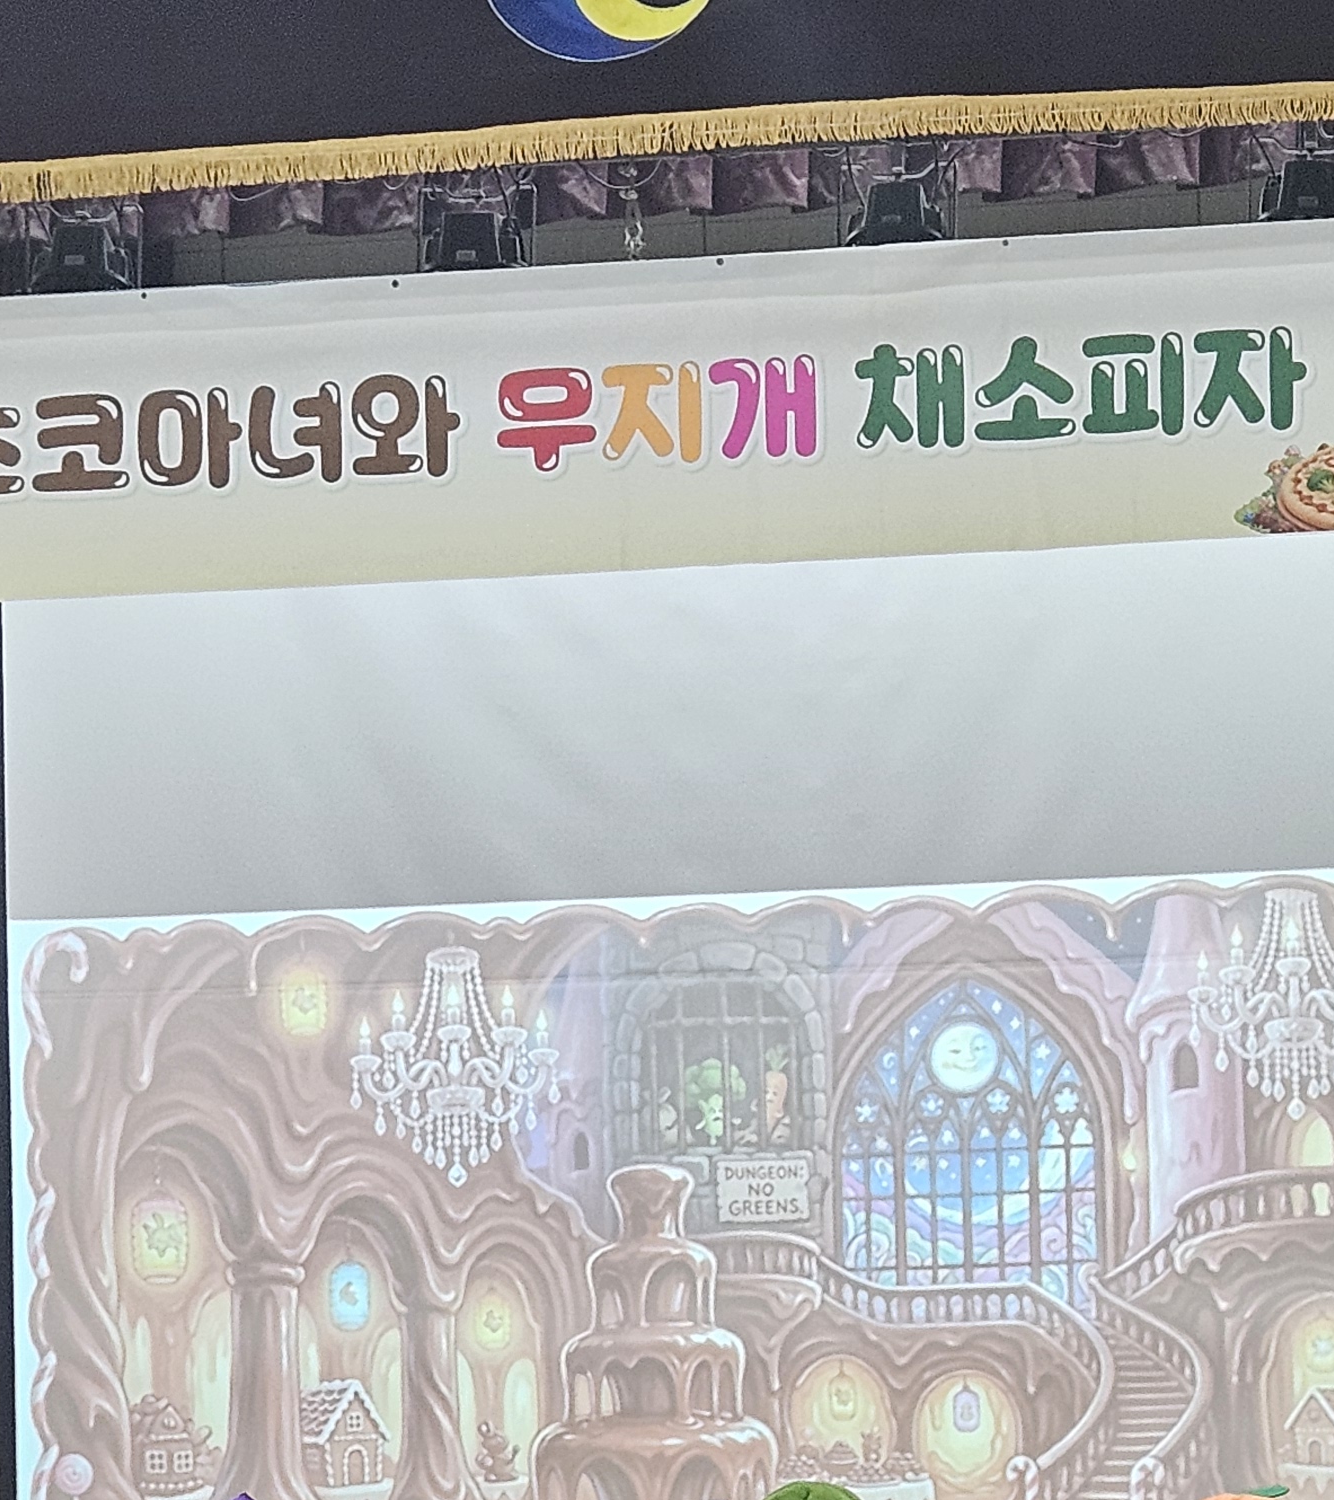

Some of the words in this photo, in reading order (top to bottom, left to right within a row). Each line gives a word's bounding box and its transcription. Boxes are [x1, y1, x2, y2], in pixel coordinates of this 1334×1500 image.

[497, 353, 818, 472] 무지개
[856, 326, 1307, 450] 채소피자
[724, 1165, 804, 1180] DUNGEON:
[748, 1183, 774, 1196] NO
[728, 1198, 805, 1217] GREENS.
